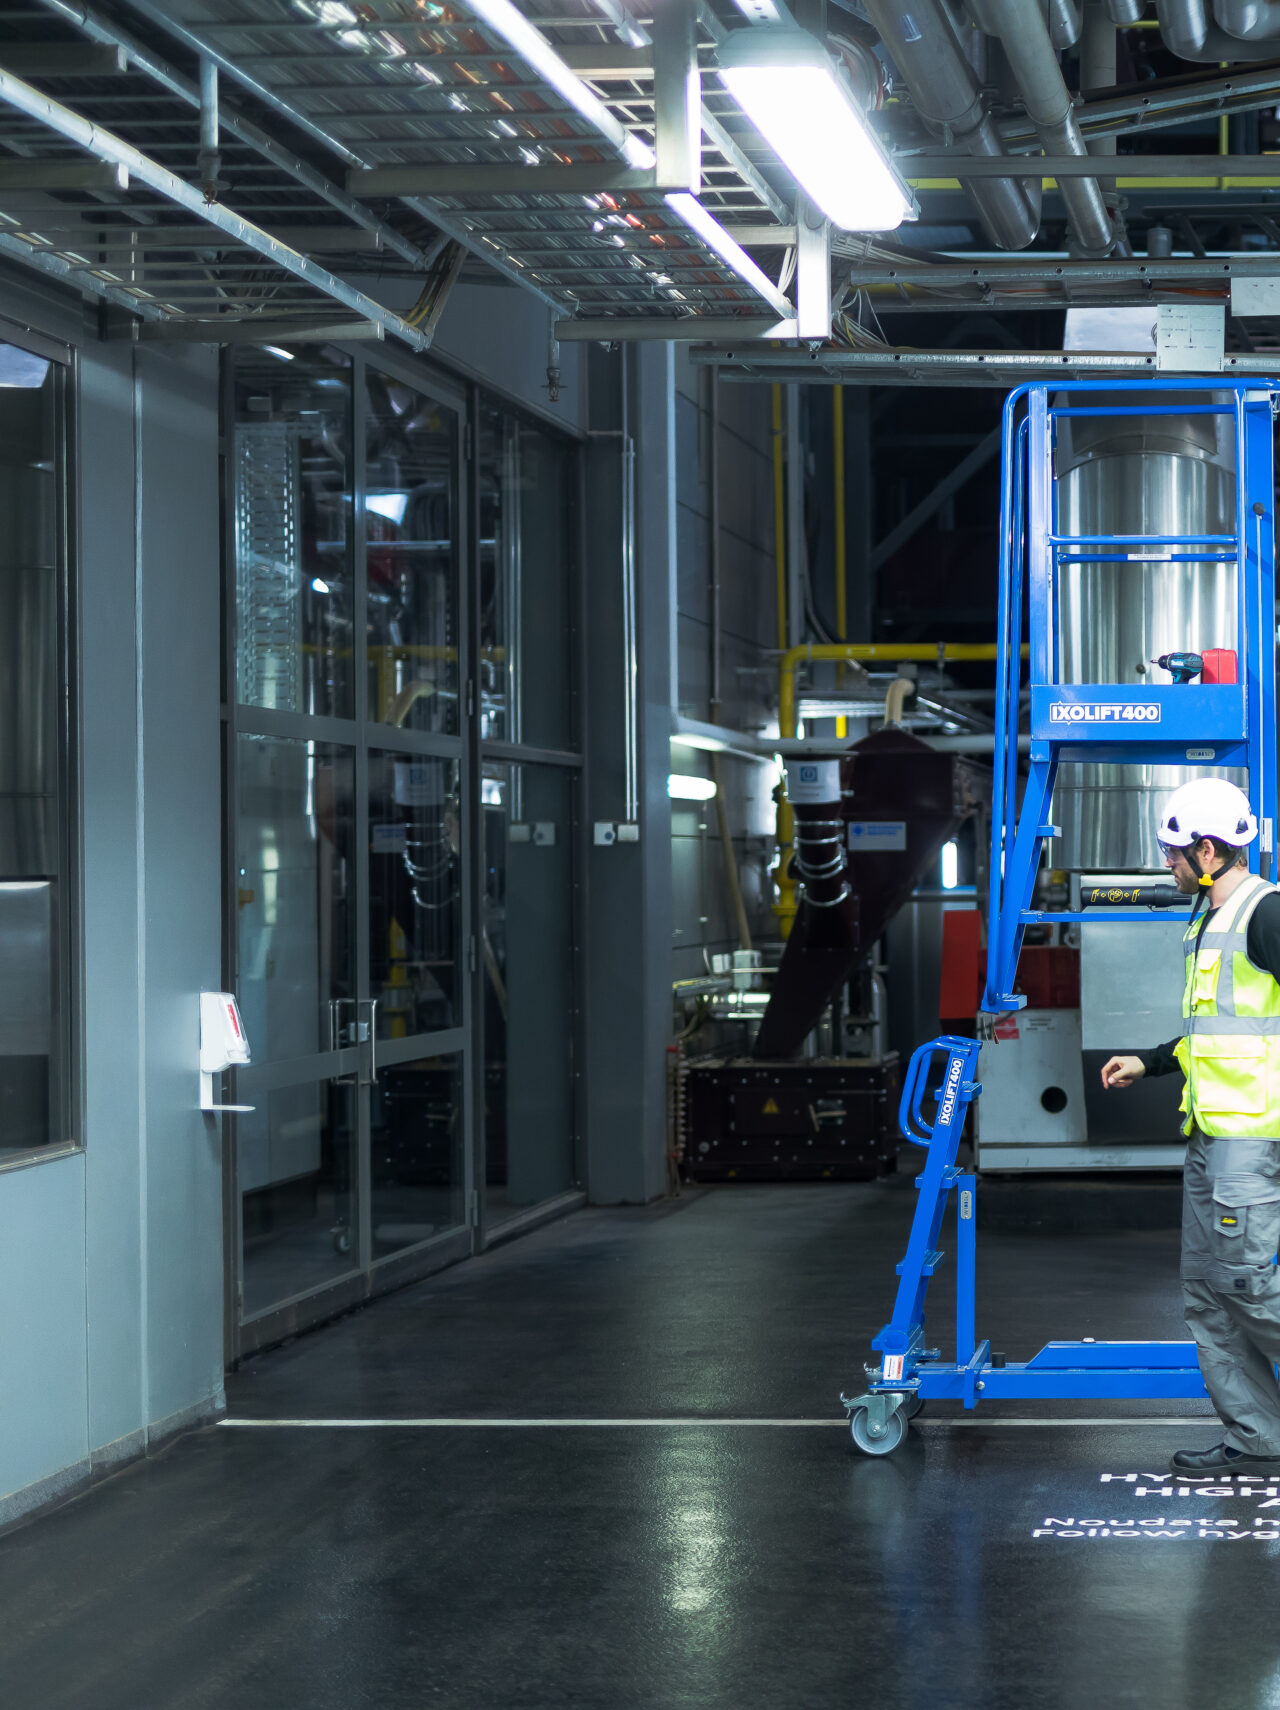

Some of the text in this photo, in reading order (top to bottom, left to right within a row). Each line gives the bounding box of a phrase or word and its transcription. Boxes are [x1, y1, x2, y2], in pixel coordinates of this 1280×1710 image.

[1052, 705, 1159, 721] IXOLIFT400
[940, 1059, 962, 1125] IXOLIFT400
[1135, 1486, 1278, 1497] HIGH
[1043, 1517, 1239, 1527] Noudata
[1032, 1528, 1186, 1538] Follow
